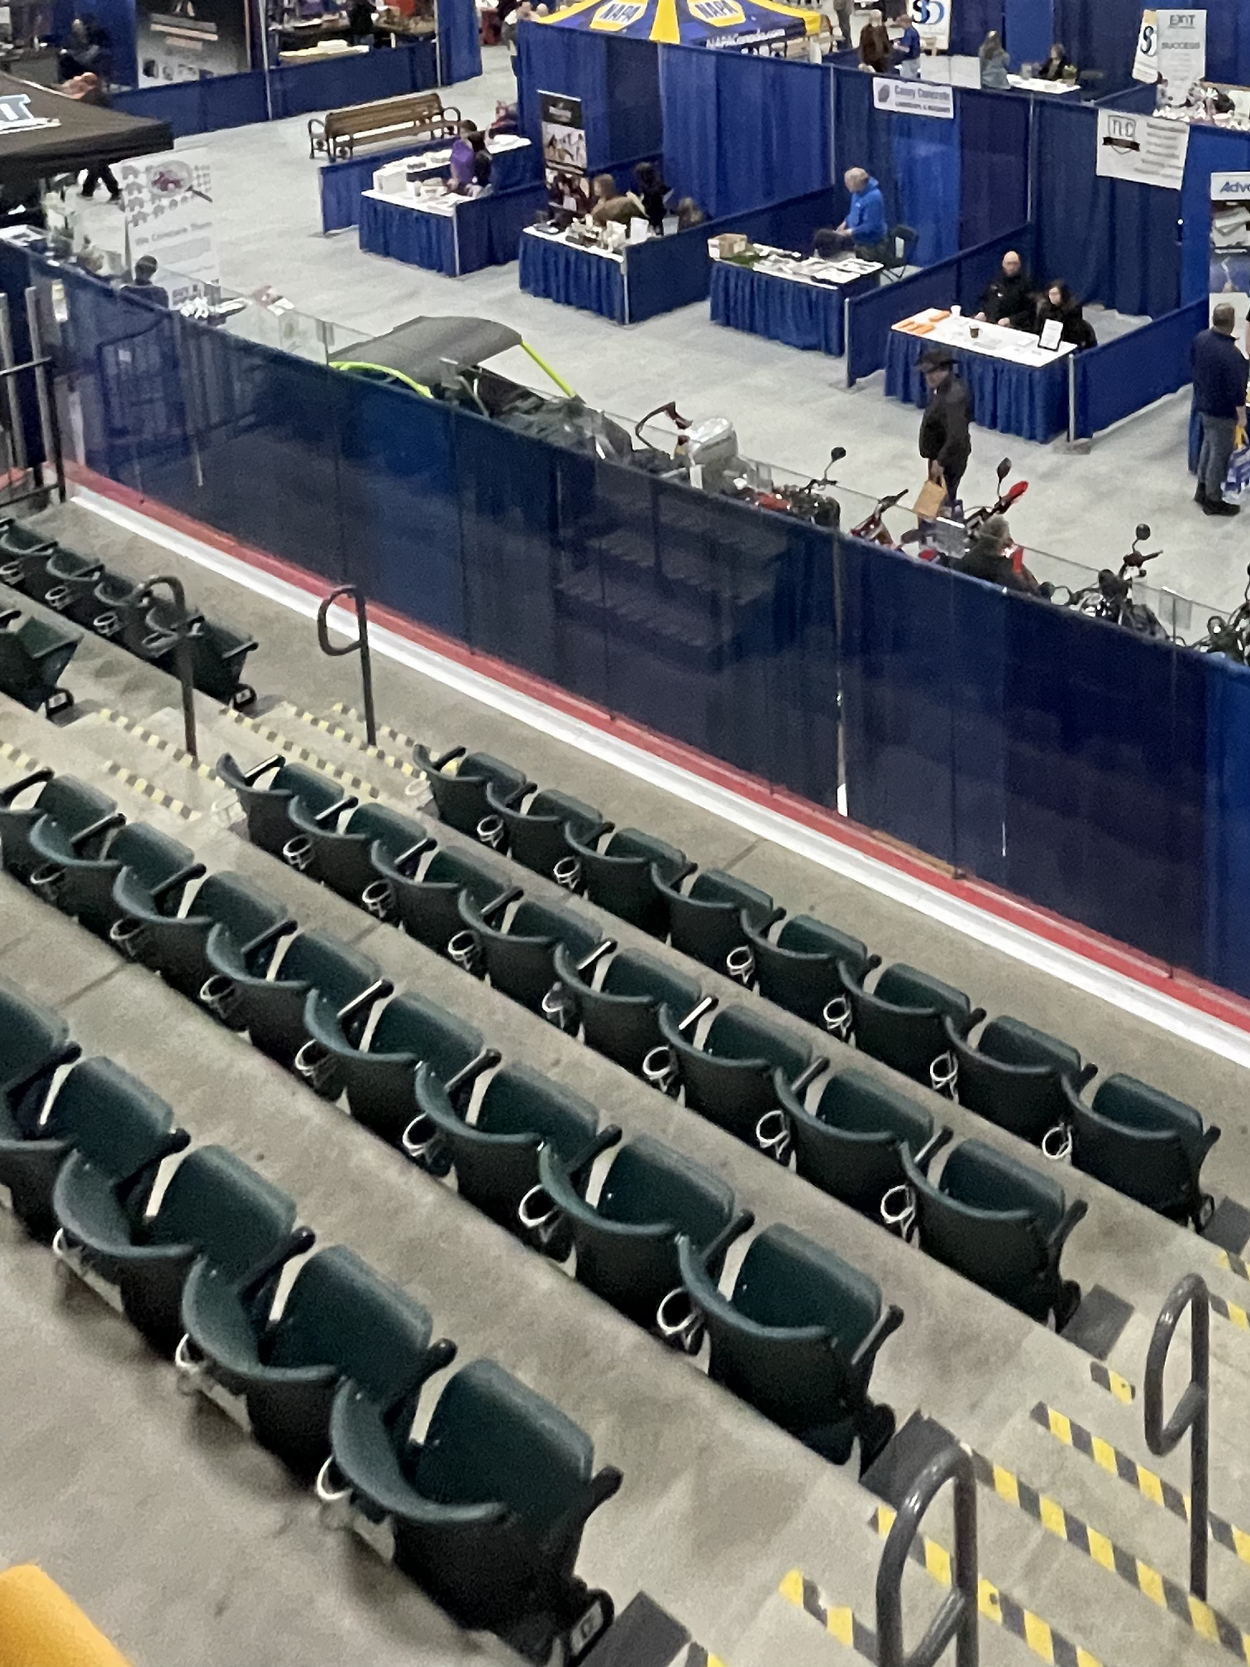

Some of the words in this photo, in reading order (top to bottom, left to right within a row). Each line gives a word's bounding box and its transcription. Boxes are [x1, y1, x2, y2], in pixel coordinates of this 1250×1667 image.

[599, 3, 640, 22] NAPA
[695, 0, 738, 19] NAPA
[1169, 14, 1196, 26] EXIT
[1161, 41, 1200, 50] SUCCESS
